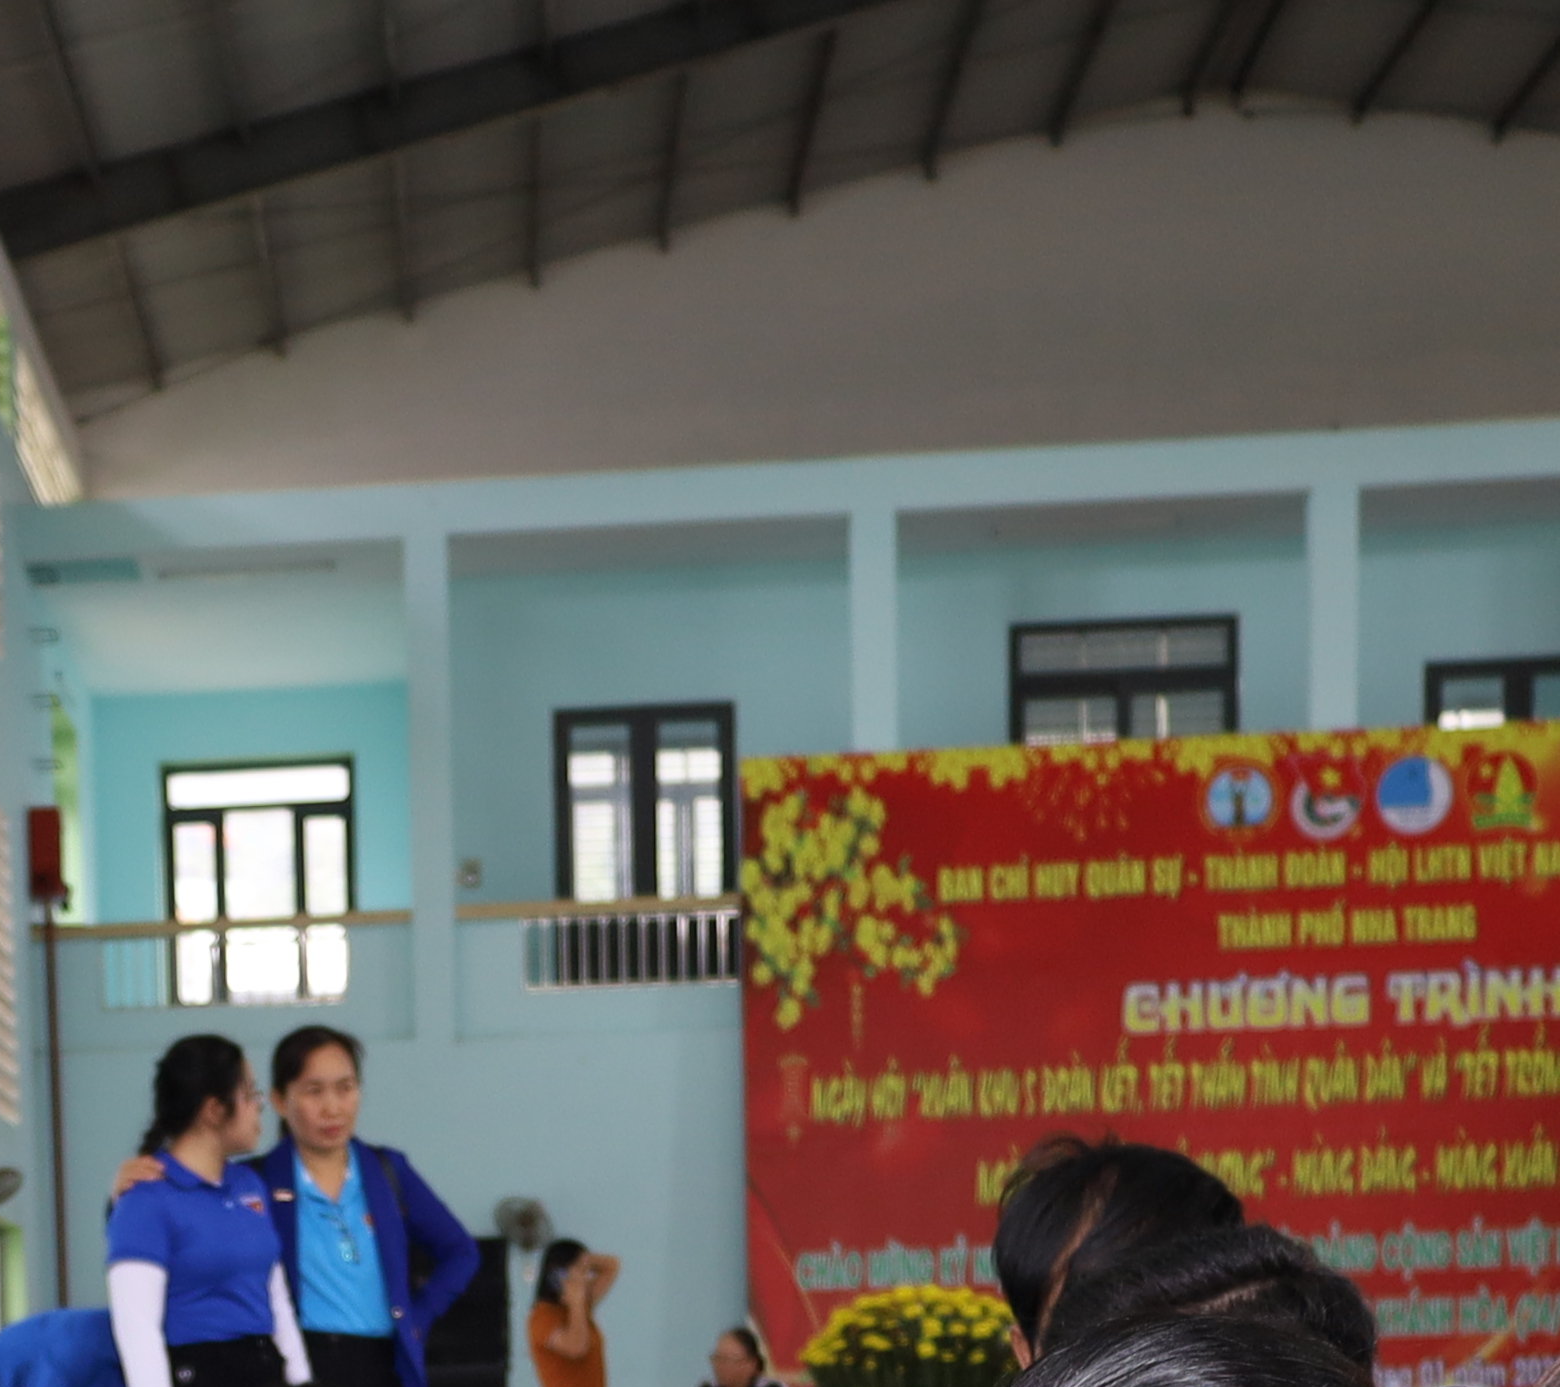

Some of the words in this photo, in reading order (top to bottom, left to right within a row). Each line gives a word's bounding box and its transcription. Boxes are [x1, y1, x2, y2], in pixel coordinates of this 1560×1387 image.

[938, 865, 983, 900] BAN
[1035, 863, 1080, 897] HUY
[1204, 848, 1278, 890] THÀNH
[1217, 906, 1292, 950] THÀNH
[1352, 908, 1398, 945] NHA
[1403, 904, 1478, 943] TRANG
[1122, 969, 1371, 1034] CHƯƠNG
[796, 1240, 864, 1292] CHÀO
[1382, 1220, 1452, 1281] CỘNG
[1506, 1214, 1552, 1278] VIỆT
